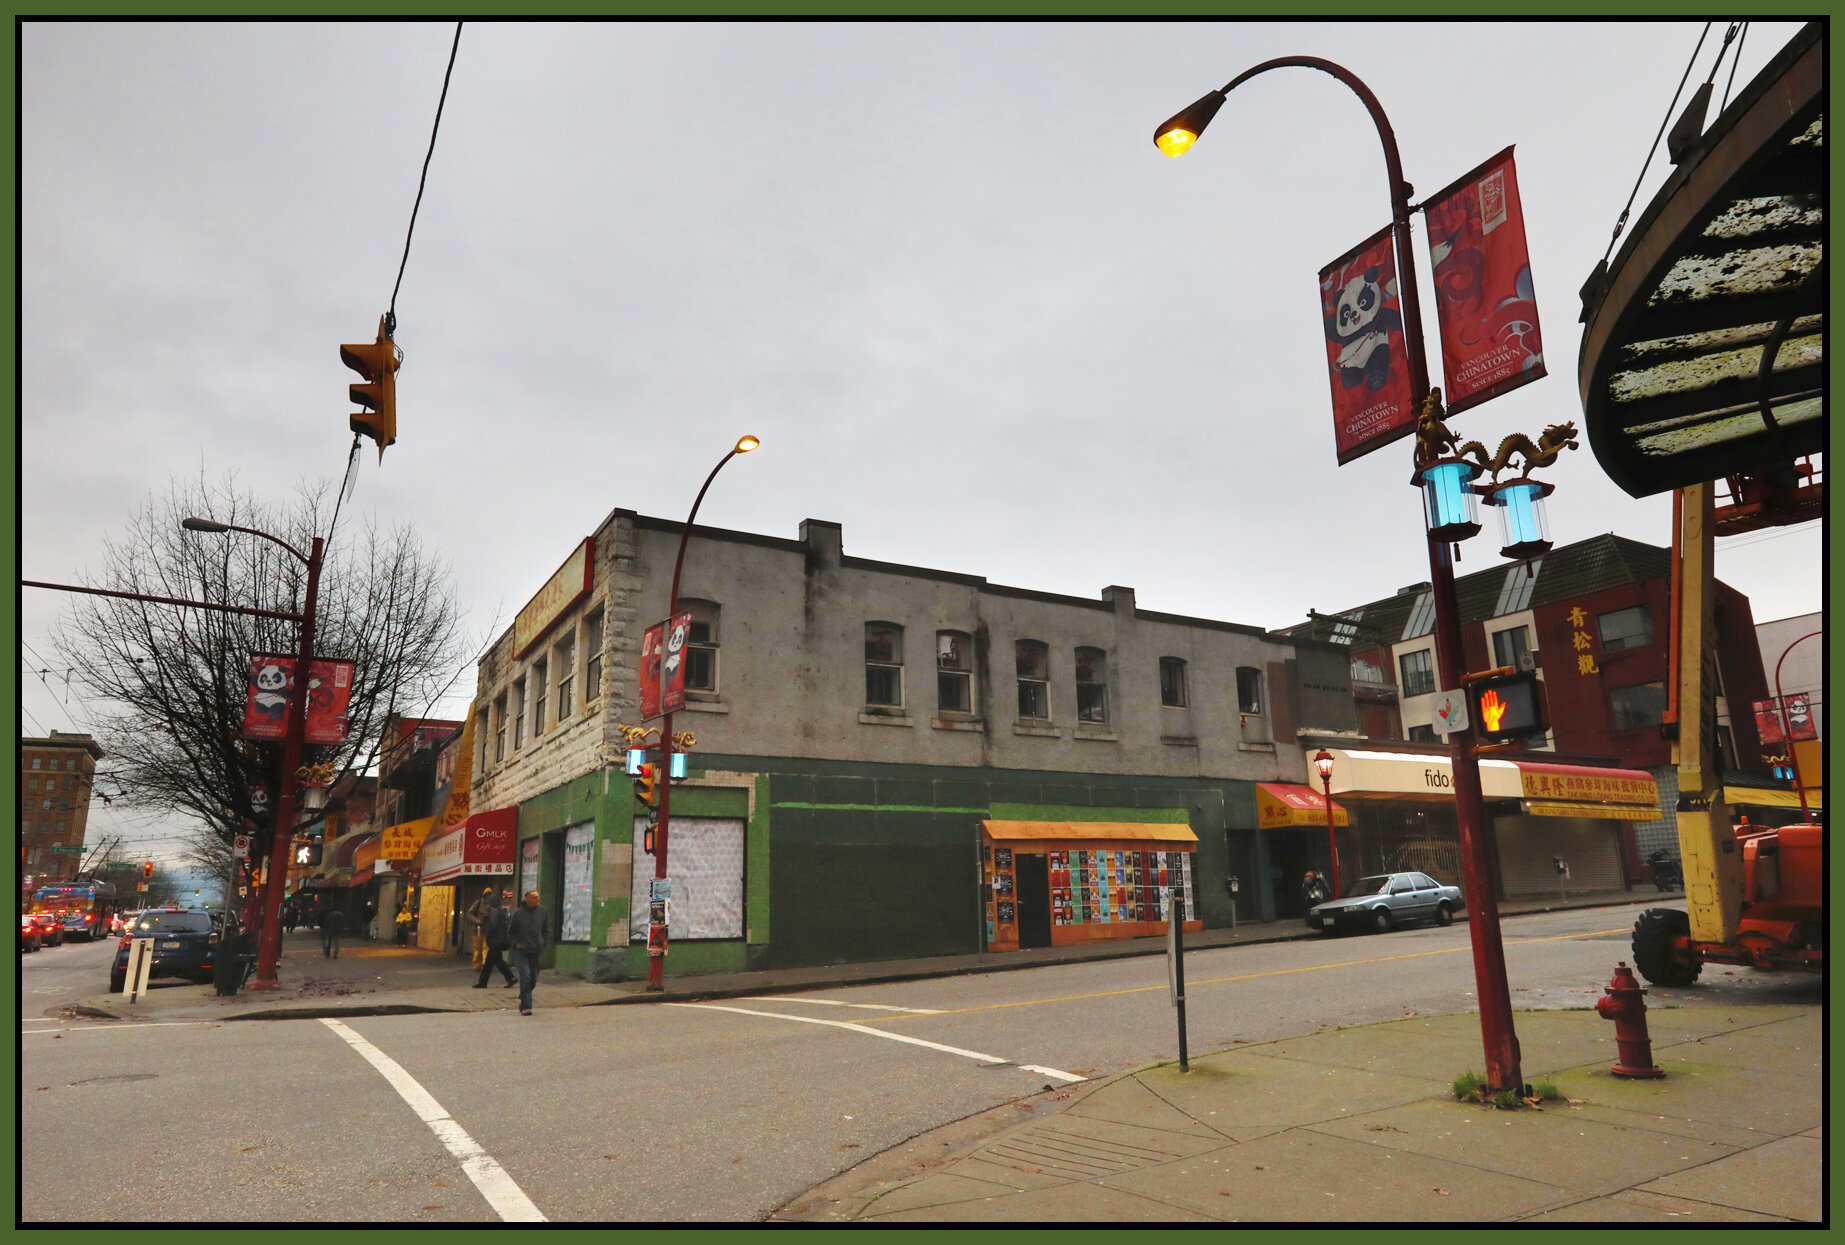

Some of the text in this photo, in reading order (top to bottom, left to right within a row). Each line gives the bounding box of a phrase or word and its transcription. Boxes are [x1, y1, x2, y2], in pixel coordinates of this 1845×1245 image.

[1456, 347, 1520, 383] CHINATOWN
[1461, 344, 1509, 370] VANCOUVER
[1472, 368, 1511, 389] SINCE 1885
[1345, 404, 1399, 434] CHINATOWN
[1351, 401, 1388, 423] VANCOUVER
[1358, 422, 1391, 441] SINCE 1885
[1566, 606, 1599, 675] 青松觀
[1424, 769, 1450, 788] fido
[476, 827, 507, 838] GMLK
